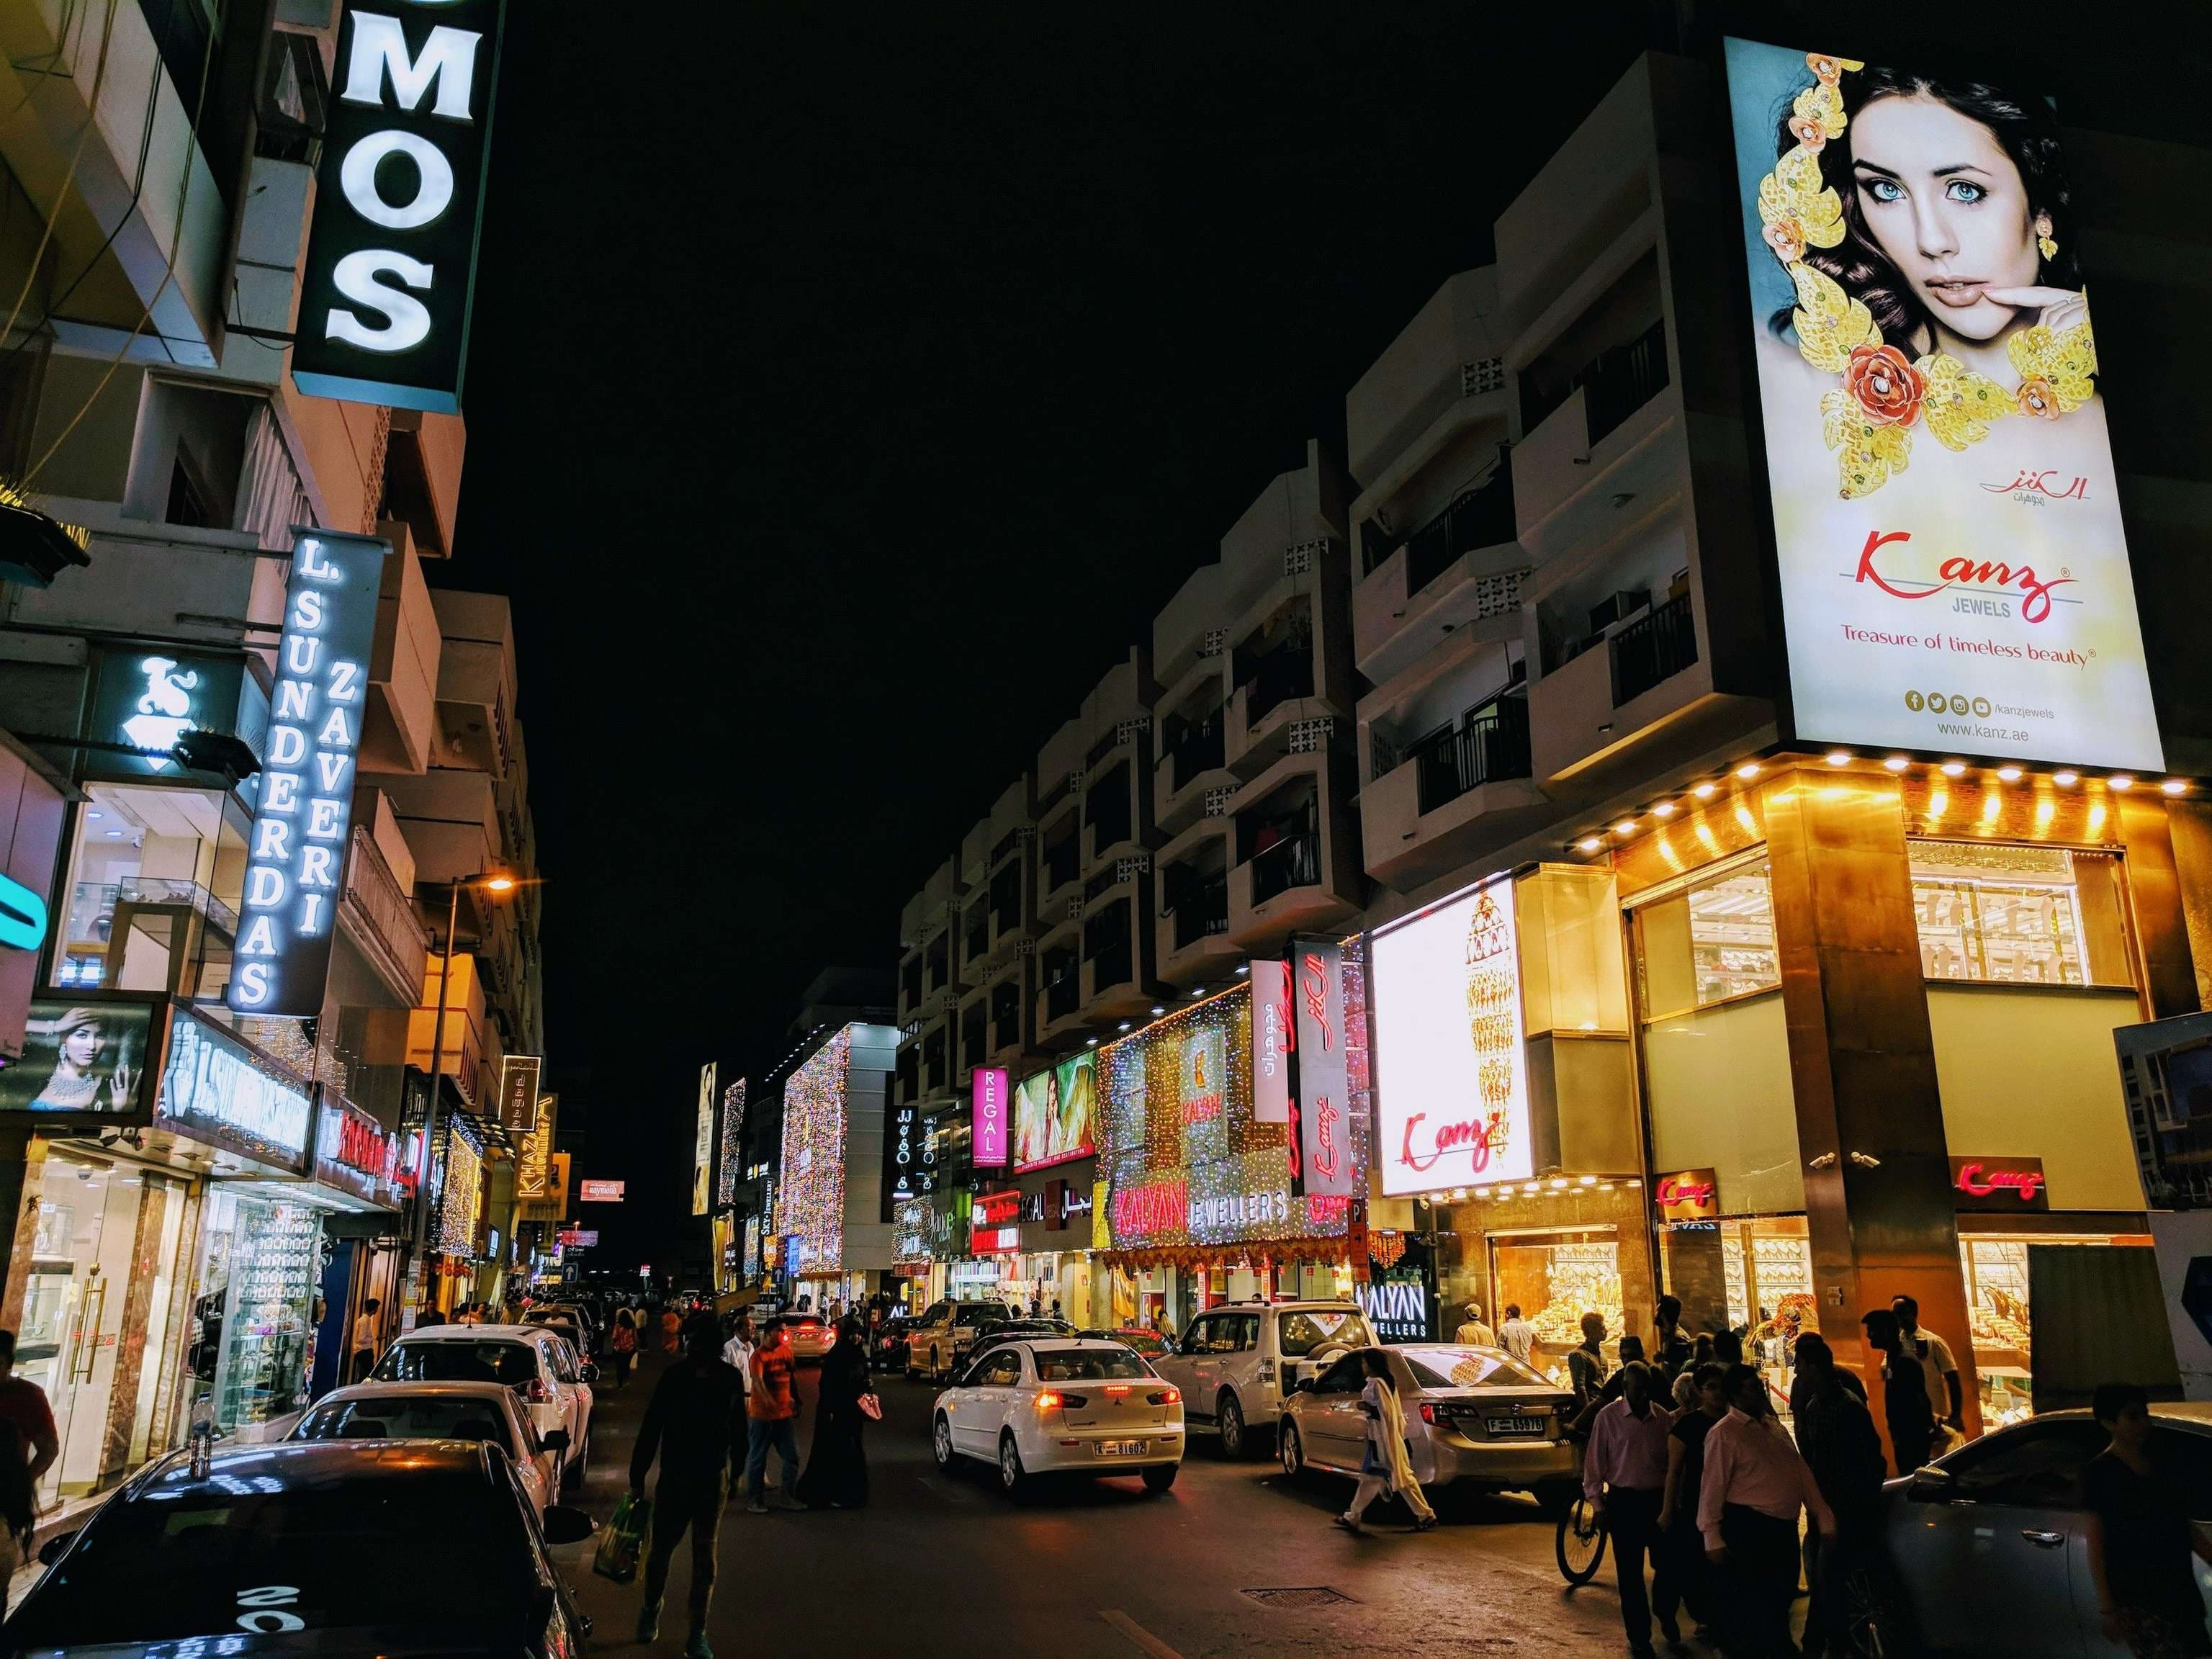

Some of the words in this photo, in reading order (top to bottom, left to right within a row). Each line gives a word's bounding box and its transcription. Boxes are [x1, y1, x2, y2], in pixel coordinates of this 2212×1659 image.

[325, 0, 483, 353] MOS
[1856, 531, 2080, 624] Kanz
[1952, 597, 2011, 619] JEWELS
[1840, 624, 1918, 647] Treasure
[1924, 634, 1942, 649] of
[1949, 637, 2023, 659] timeless
[1938, 722, 2029, 742] www.kanz.ae
[238, 590, 323, 1005] SUNDERDAS
[299, 661, 359, 935] ZAVERI
[983, 1071, 997, 1152] REGAL
[518, 1097, 553, 1197] KHAZA
[1401, 1112, 1499, 1174] Kanz
[1019, 1193, 1044, 1222] EGAL
[1116, 1180, 1187, 1236] KALYAN
[1188, 1190, 1287, 1226] JEWELLERS
[1371, 1322, 1426, 1338] WELLERS
